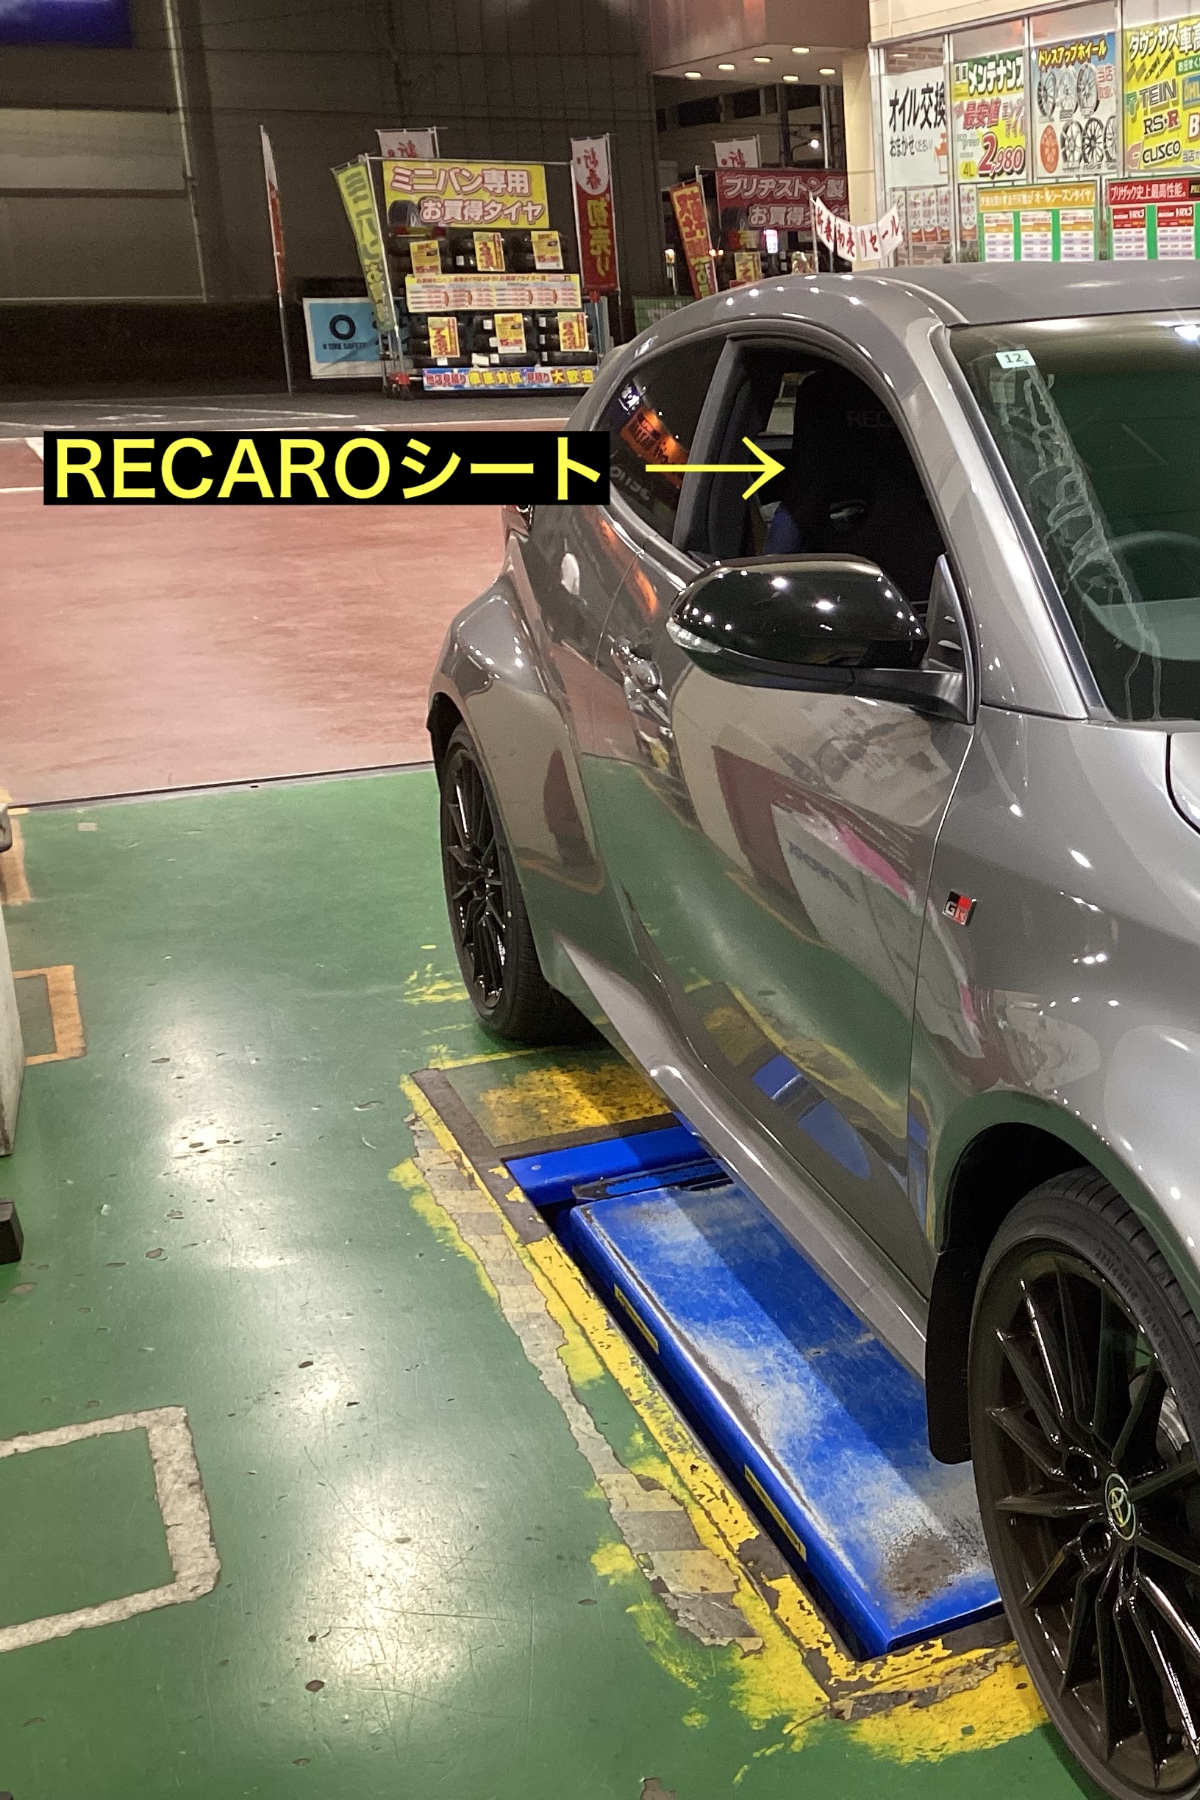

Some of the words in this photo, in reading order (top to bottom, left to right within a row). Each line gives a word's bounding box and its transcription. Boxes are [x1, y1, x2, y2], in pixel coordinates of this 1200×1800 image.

[1038, 38, 1108, 68] ドレスアップホイール
[889, 80, 947, 132] オイル交換
[1139, 79, 1178, 106] TEIN
[963, 98, 1001, 130] 最安値
[977, 131, 1026, 179] 2,980
[1142, 140, 1182, 164] CUSCO
[390, 165, 530, 194] ミニバン専用
[962, 162, 975, 177] 4L
[420, 200, 543, 224] お買得タイヤ
[1004, 353, 1024, 364] 12
